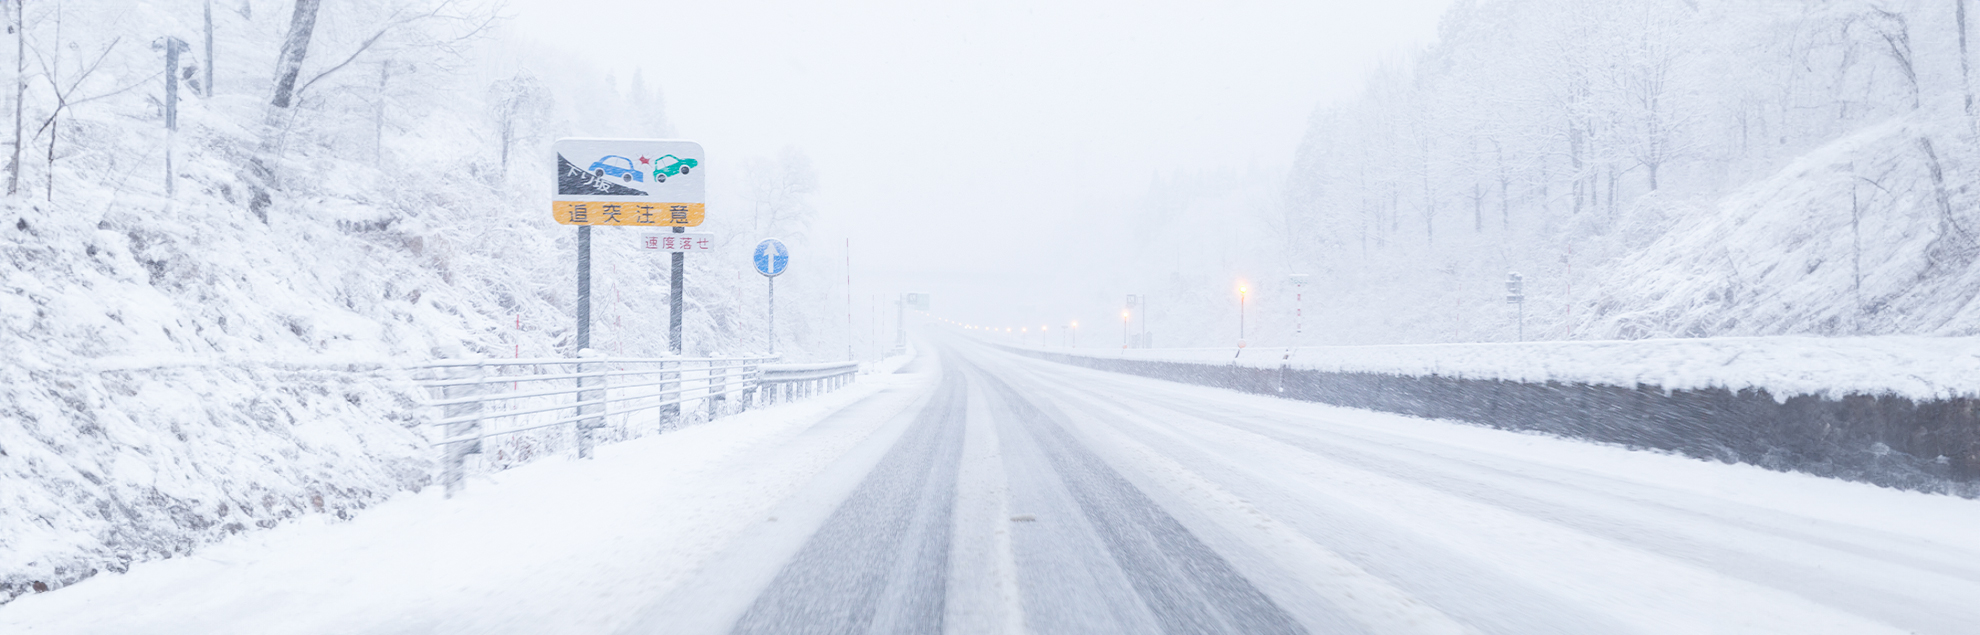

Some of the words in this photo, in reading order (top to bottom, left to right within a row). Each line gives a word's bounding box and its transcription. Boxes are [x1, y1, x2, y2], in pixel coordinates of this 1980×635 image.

[566, 162, 612, 193] 下り坂
[568, 204, 688, 224] 追突注意
[645, 236, 709, 250] 速度落せ
